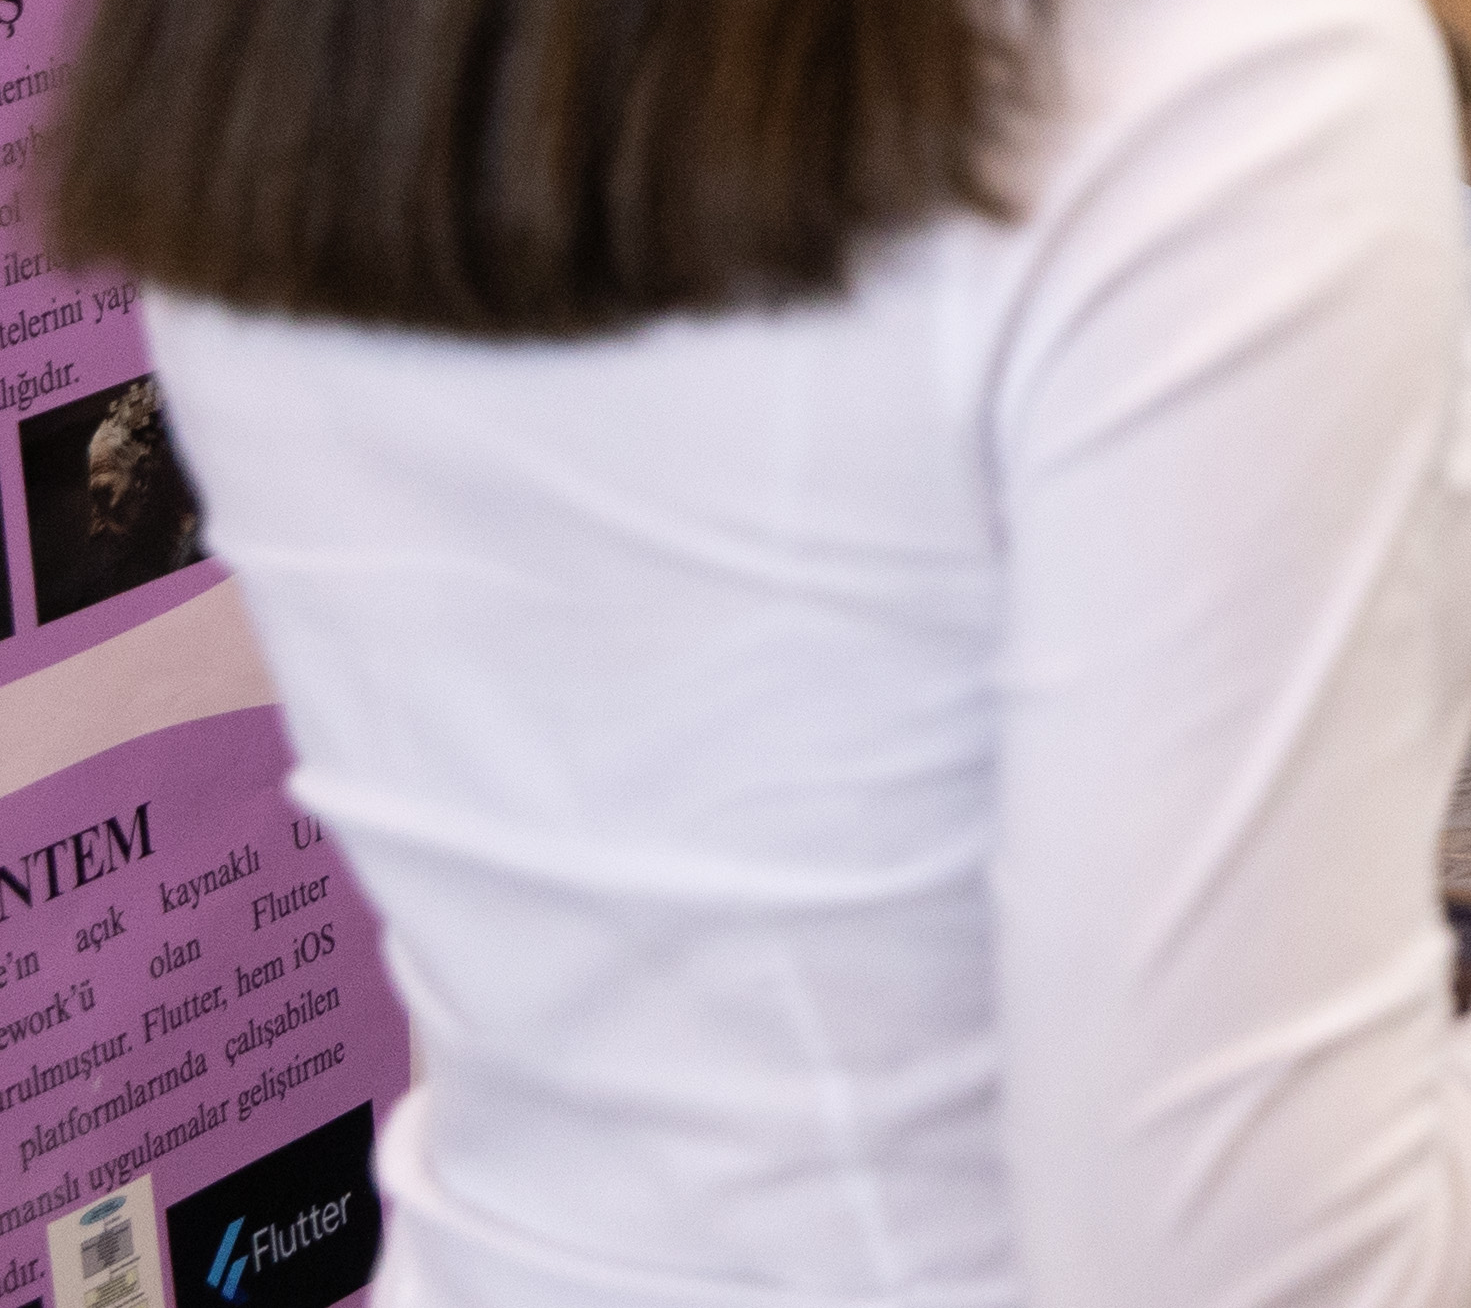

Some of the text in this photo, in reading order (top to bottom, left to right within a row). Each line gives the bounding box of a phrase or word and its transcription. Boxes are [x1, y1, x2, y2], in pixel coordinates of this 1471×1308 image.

[76, 906, 127, 953] açık
[160, 843, 261, 913] kaynaklı
[150, 939, 202, 979] olan
[251, 875, 329, 931] Flutter
[235, 956, 286, 998] hem
[293, 922, 336, 970] iOS
[19, 987, 341, 1173] platformlarında çalışabilen
[89, 1097, 231, 1193] uygulamalar
[238, 1042, 345, 1123] geliştirme
[253, 1191, 351, 1272] Flutter
